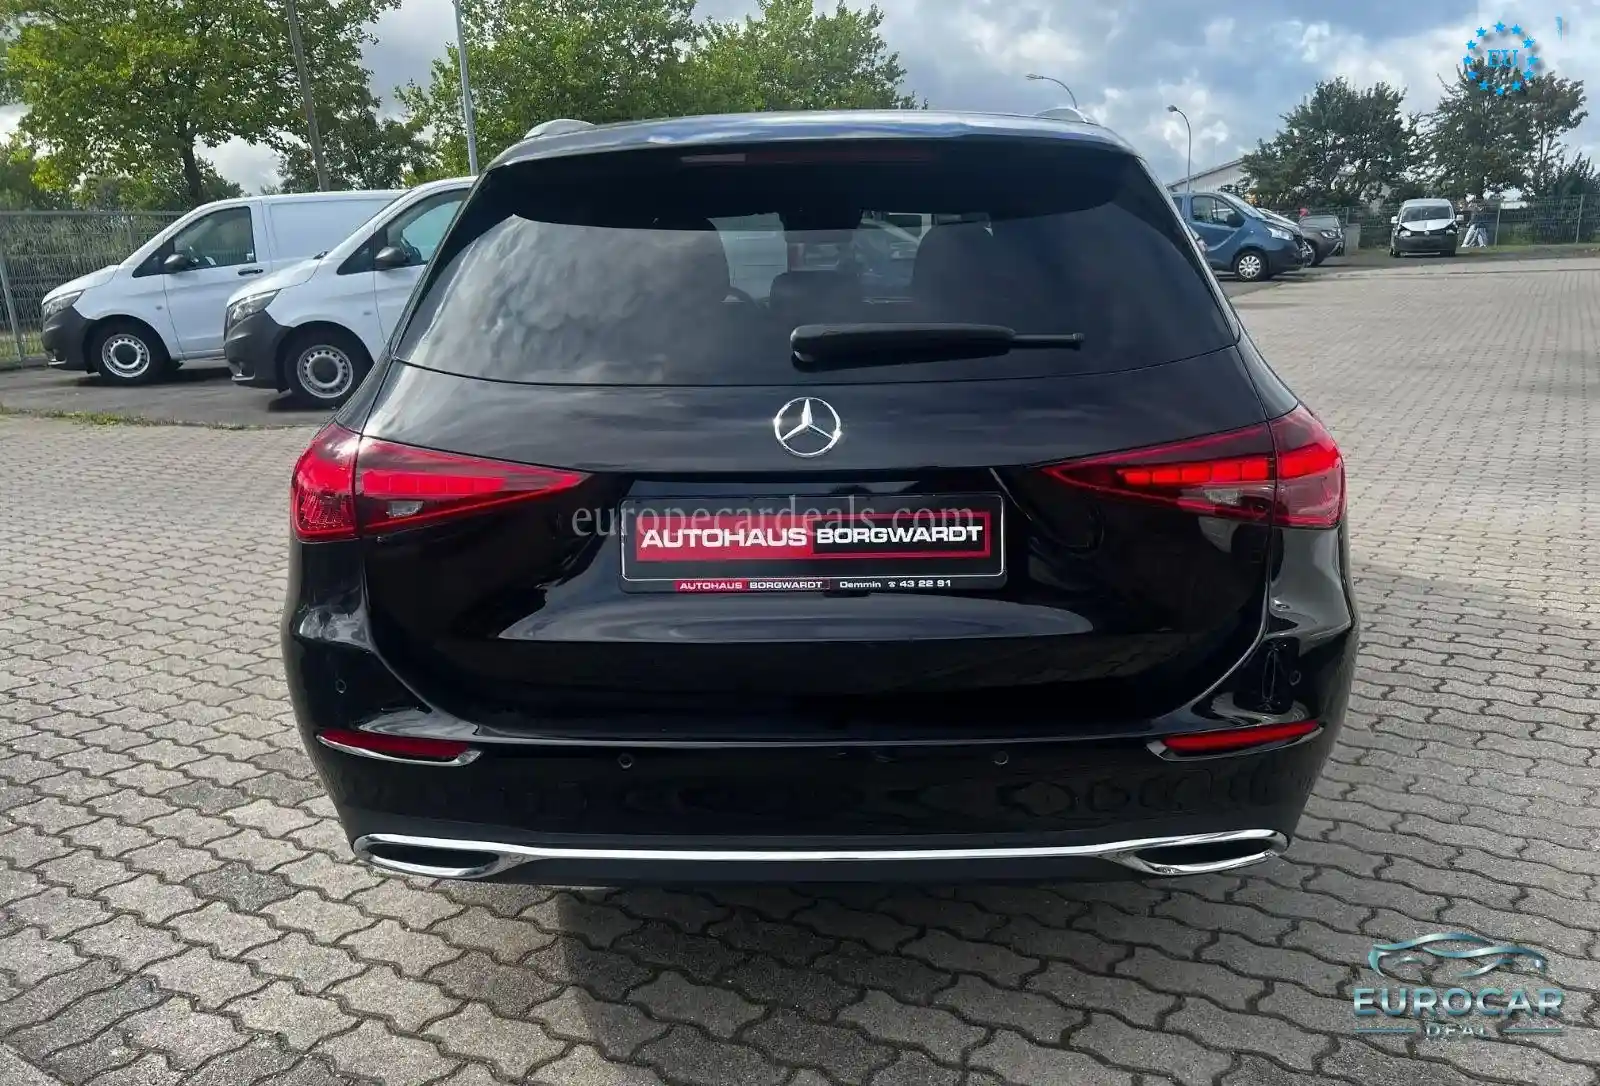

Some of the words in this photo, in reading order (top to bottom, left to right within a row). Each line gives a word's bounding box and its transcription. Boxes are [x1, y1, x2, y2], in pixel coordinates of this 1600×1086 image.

[640, 527, 807, 548] AUTOHAUS
[816, 525, 983, 544] BORGWARDT
[680, 581, 743, 590] AUTOHAUS
[749, 581, 823, 589] BORGWARDT
[839, 580, 882, 588] Demmin
[899, 579, 915, 587] 43
[917, 579, 934, 587] 22
[936, 579, 952, 587] 91
